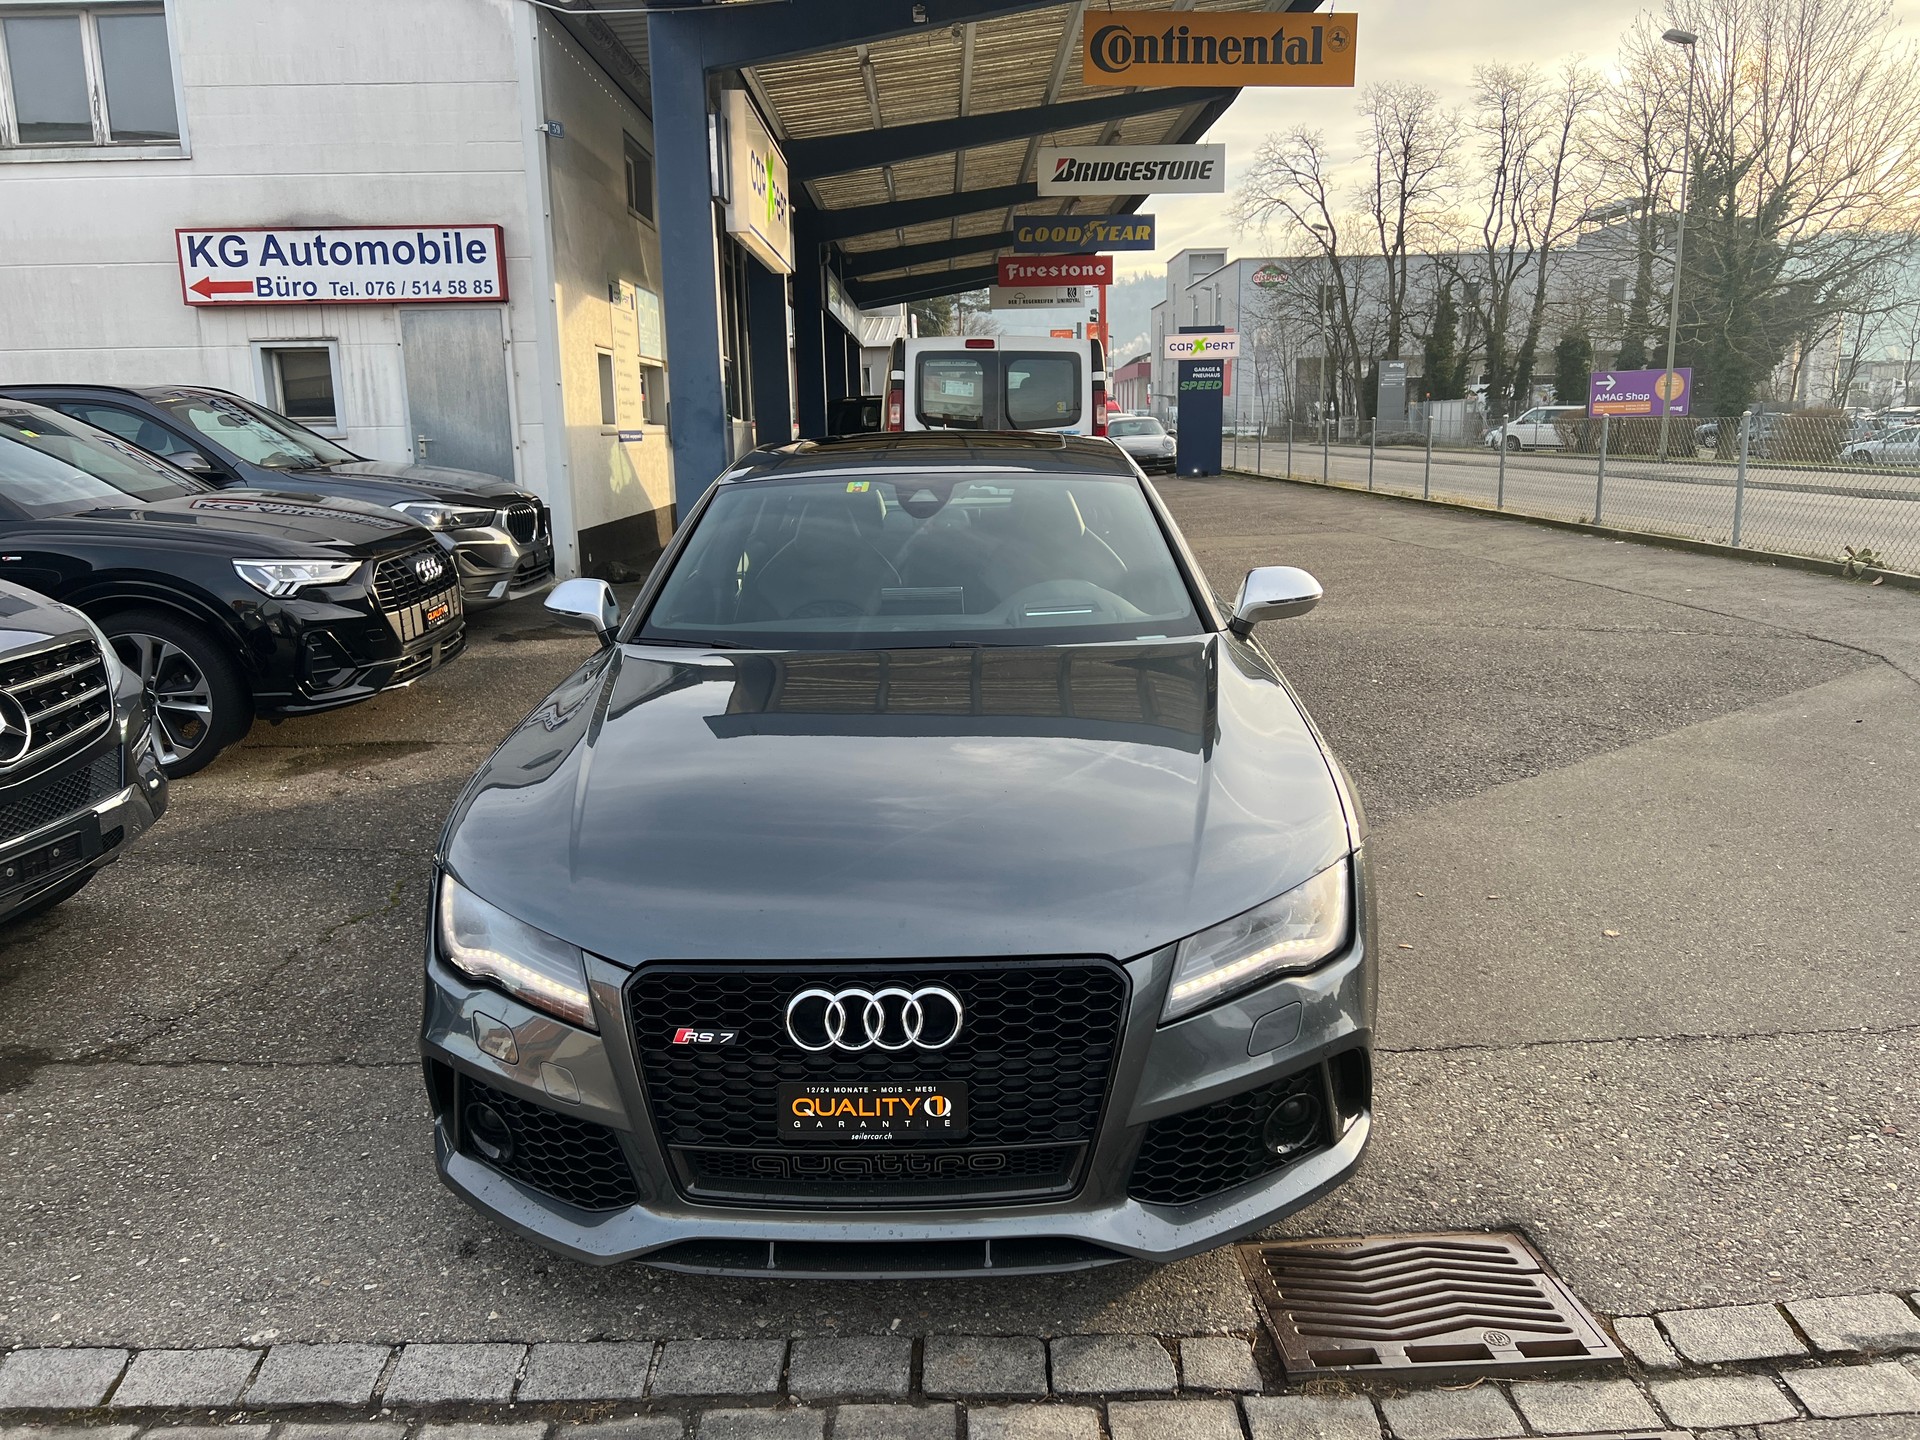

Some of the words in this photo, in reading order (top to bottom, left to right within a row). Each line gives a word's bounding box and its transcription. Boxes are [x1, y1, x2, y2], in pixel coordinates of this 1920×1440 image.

[1090, 25, 1323, 73] Continental
[1051, 158, 1214, 182] BRIDGESTONE
[187, 235, 249, 267] KG
[260, 232, 487, 266] Automobile
[1005, 263, 1106, 281] Firestone
[256, 276, 318, 298] Büro
[329, 281, 360, 297] Tel.
[365, 280, 396, 296] 076
[412, 280, 442, 295] 514
[448, 280, 468, 295] 58
[473, 279, 494, 295] 85
[1180, 380, 1222, 391] SPEED
[1595, 393, 1623, 402] AMAG
[1625, 392, 1650, 402] Shop
[791, 1097, 921, 1117] QUALITY
[793, 1119, 951, 1128] GARANTIE
[851, 1132, 893, 1140] seilercar.ch
[752, 1152, 1005, 1179] quattro
